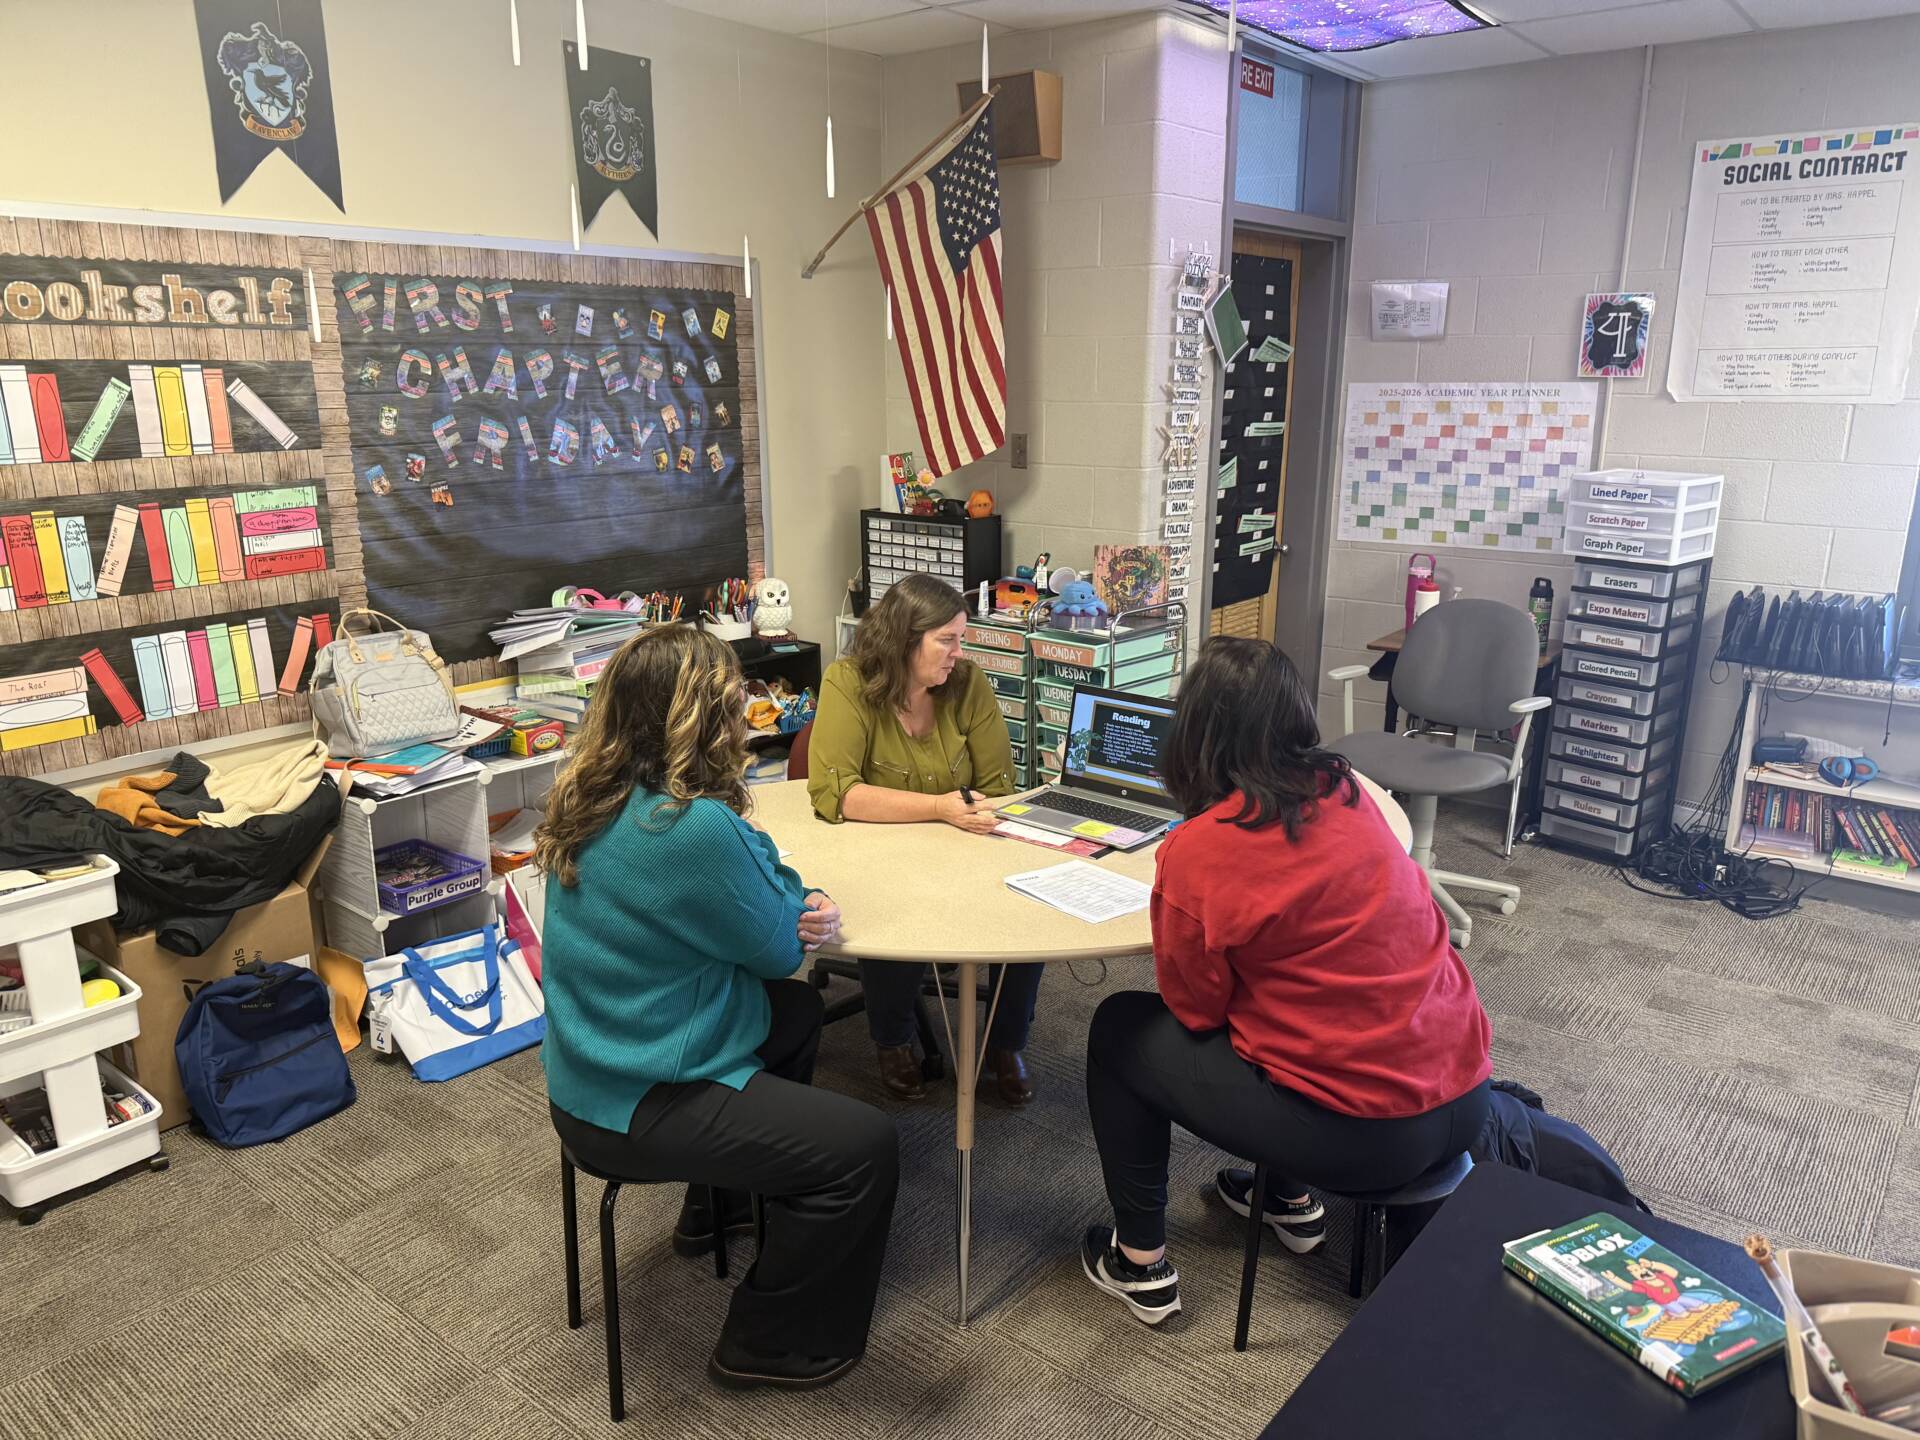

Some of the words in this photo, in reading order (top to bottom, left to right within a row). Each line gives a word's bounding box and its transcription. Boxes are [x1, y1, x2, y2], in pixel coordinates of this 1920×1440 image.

[1241, 62, 1252, 86] RE
[1254, 67, 1273, 92] EXIT
[1724, 161, 1791, 186] SOCIAL
[1799, 151, 1907, 179] CONTRACT
[1740, 197, 1757, 207] HOW
[1760, 197, 1769, 205] TO
[1770, 196, 1780, 205] BE
[1781, 194, 1811, 204] TREATED
[1813, 193, 1822, 202] BY
[1751, 249, 1768, 259] HOW
[1770, 249, 1779, 258] TO
[1781, 248, 1802, 257] TREAT
[1804, 247, 1823, 256] EACH
[1825, 246, 1849, 255] OTHER
[0, 269, 294, 325] ookshelf
[341, 273, 514, 335] FIRST
[1771, 302, 1792, 310] TREAT
[1716, 354, 1733, 362] HOW
[1735, 354, 1744, 362] TO
[1745, 354, 1767, 362] TREAT
[1767, 353, 1792, 361] OTHERS
[1792, 353, 1819, 361] DURING
[1821, 352, 1858, 361] CONFLICT
[395, 344, 664, 402] CHAPTER
[1378, 389, 1422, 398] 2025-2026
[1424, 388, 1477, 398] ACADEMIC
[1481, 388, 1509, 398] YEAR
[1511, 388, 1561, 398] PLANNER
[431, 413, 657, 472] FRIDAY
[1167, 479, 1195, 491] ADVENTURE
[1592, 487, 1618, 499] Lined
[1620, 489, 1649, 502] Paper
[1171, 502, 1188, 512] DRAMA
[1167, 523, 1190, 534] FOLKTALE
[1588, 514, 1618, 526] Scratch
[1620, 516, 1646, 529] Paper
[1169, 545, 1190, 558] OGRAPHY
[1584, 537, 1611, 551] Graph
[1614, 540, 1644, 554] Paper
[1603, 576, 1638, 590] Erasers
[1168, 587, 1184, 598] ORROR
[1588, 603, 1608, 617] Expo
[1610, 605, 1647, 620] Makers
[976, 631, 1011, 647] SPELLING
[1595, 634, 1624, 647] Pencils
[1042, 645, 1083, 659] MONDAY
[966, 654, 990, 666] SOCIAL
[991, 656, 1018, 671] STUDIES
[1054, 664, 1092, 683] TUESDAY
[1579, 662, 1609, 675] Colored
[1610, 666, 1636, 679] Pencils
[1044, 686, 1073, 703] WEDNE
[1585, 692, 1618, 706] Crayons
[1050, 709, 1069, 723] THUR
[1112, 712, 1151, 729] Reading
[1580, 719, 1618, 733] Markers
[1570, 745, 1619, 763] Highlighters
[1579, 775, 1601, 787] Glue
[1573, 800, 1602, 815] Rulers
[408, 887, 444, 907] Purple
[446, 877, 480, 895] Group
[376, 1032, 385, 1045] 4
[1560, 1232, 1633, 1266] OBLOX
